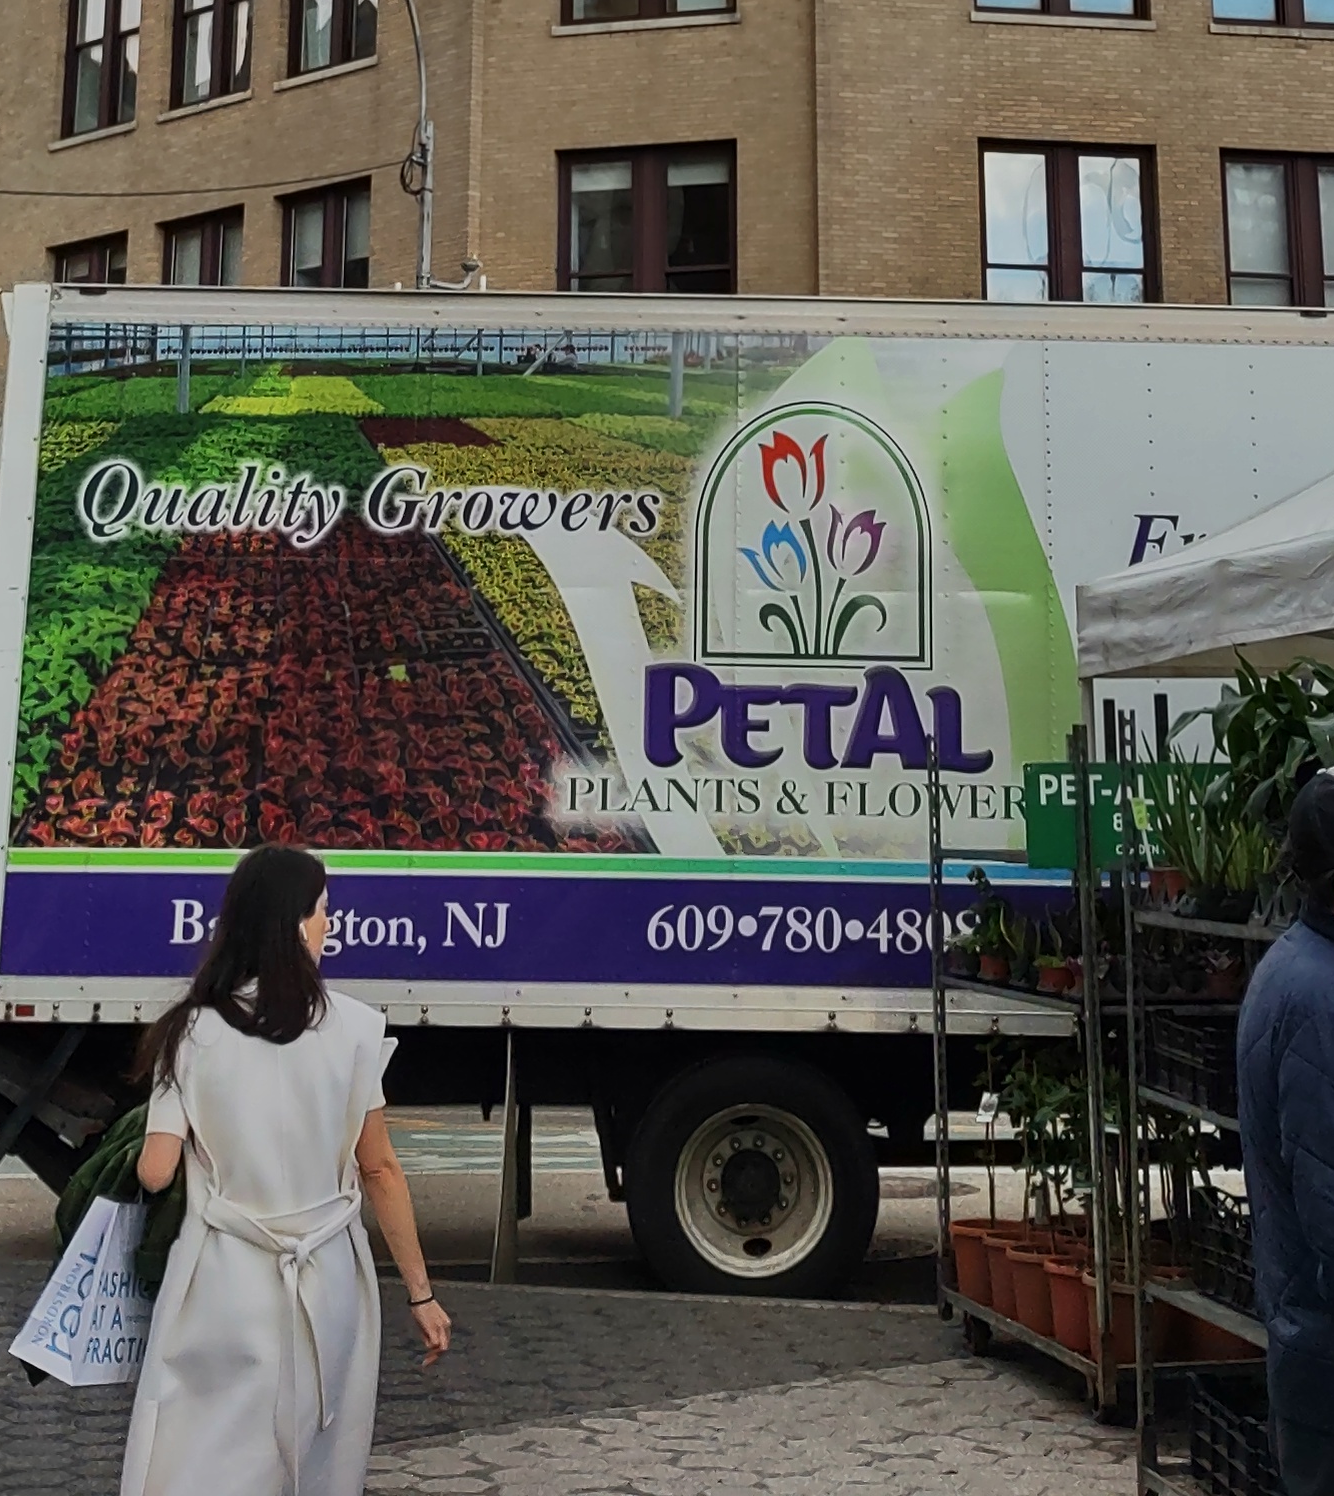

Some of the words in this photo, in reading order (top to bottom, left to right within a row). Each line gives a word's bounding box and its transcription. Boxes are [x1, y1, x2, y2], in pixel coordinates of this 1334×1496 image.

[82, 463, 341, 544] Quality
[368, 467, 660, 533] Growers
[644, 662, 993, 773] PETAL
[566, 776, 761, 814] PLANTS
[776, 779, 809, 815] &
[824, 780, 1026, 820] FLOWER
[169, 899, 427, 956] Bgton,
[442, 902, 510, 948] NJ
[31, 1262, 82, 1345] NORDSTROM
[98, 1271, 155, 1301] FASHIO
[110, 1304, 123, 1332] A
[83, 1336, 147, 1365] FRACTI
